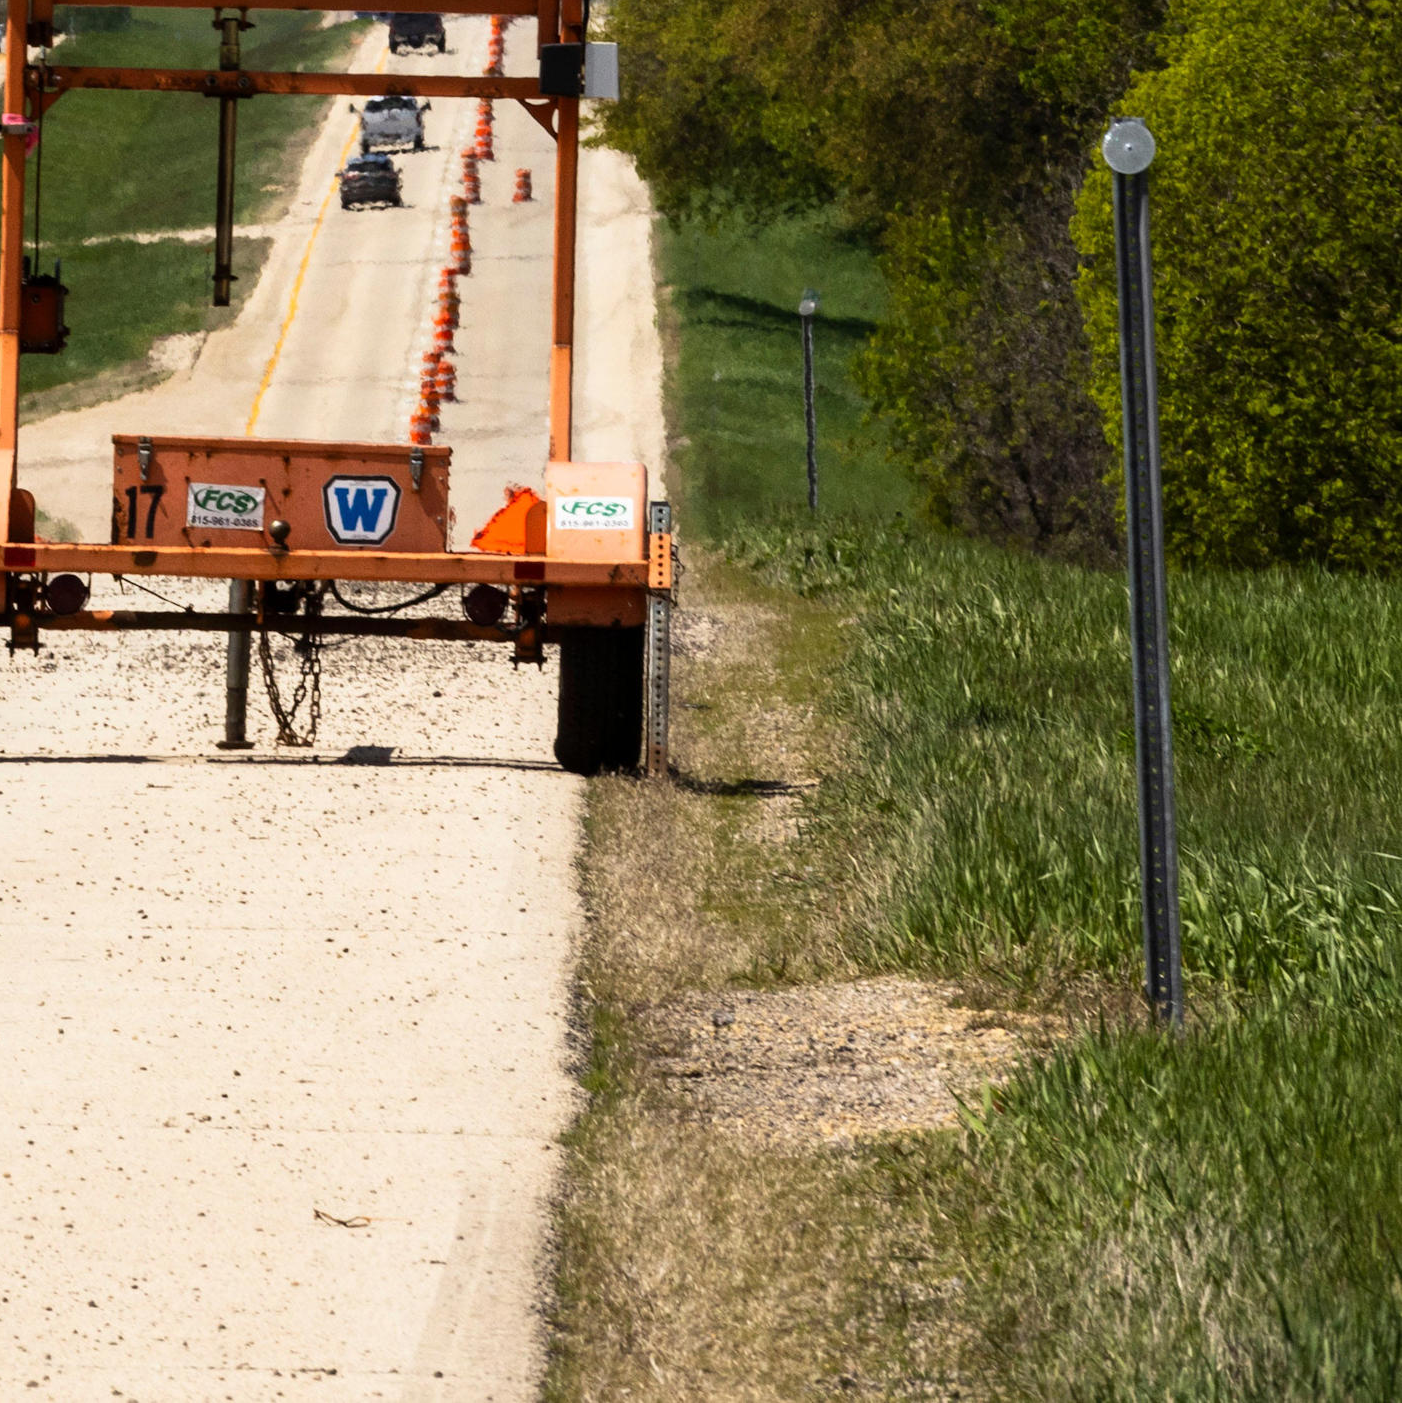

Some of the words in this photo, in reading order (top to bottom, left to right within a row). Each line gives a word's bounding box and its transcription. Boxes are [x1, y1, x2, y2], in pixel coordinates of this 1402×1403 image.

[125, 485, 165, 539] 17
[202, 488, 250, 514] FCS
[334, 487, 388, 532] W
[571, 501, 619, 517] FCS
